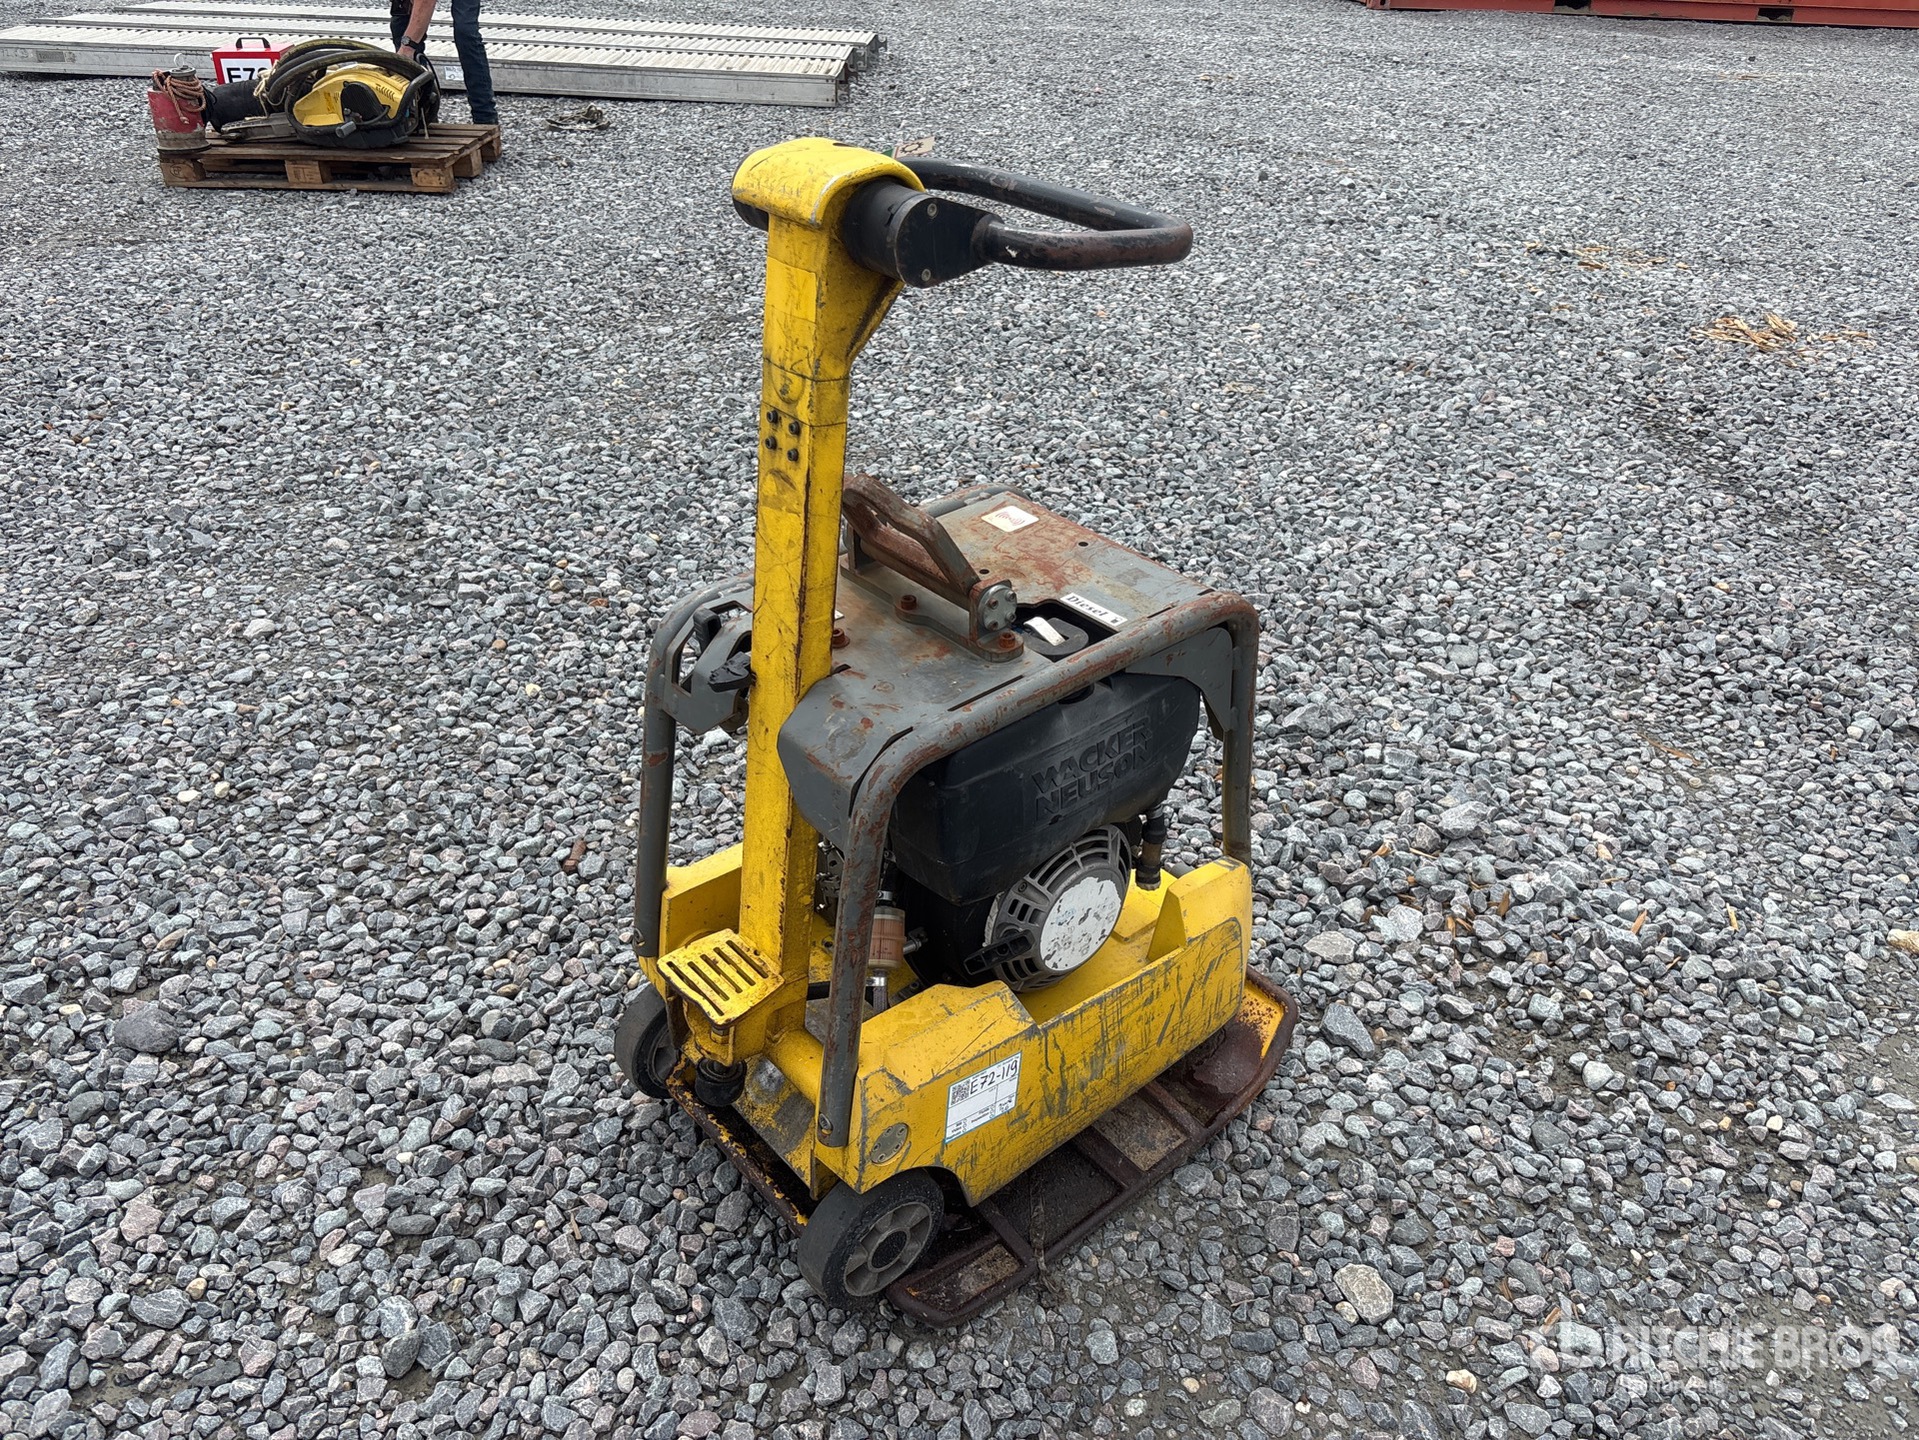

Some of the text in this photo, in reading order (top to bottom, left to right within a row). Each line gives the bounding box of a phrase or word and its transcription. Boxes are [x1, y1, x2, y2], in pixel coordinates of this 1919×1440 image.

[1066, 595, 1109, 617] Diesel
[1031, 717, 1153, 794] WACKER
[1035, 741, 1152, 822] NEUSON
[970, 1059, 1018, 1095] E72-119
